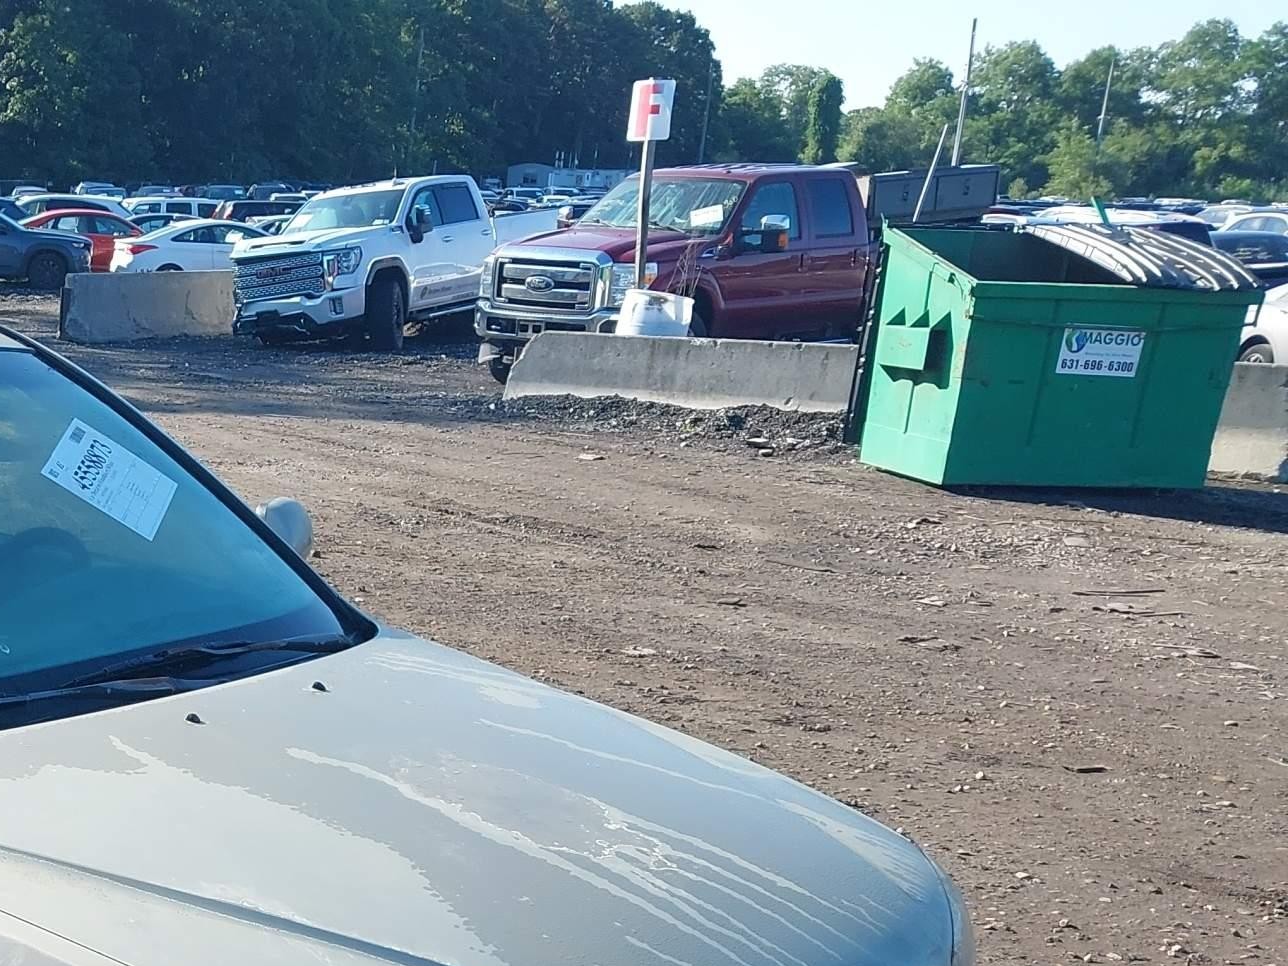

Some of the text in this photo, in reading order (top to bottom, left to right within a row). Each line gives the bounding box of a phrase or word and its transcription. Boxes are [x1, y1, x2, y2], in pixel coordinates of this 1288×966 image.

[634, 84, 664, 138] F
[1085, 332, 1141, 346] MAGGIO
[1061, 359, 1134, 372] 631-696-6300
[71, 438, 113, 491] 45558873
